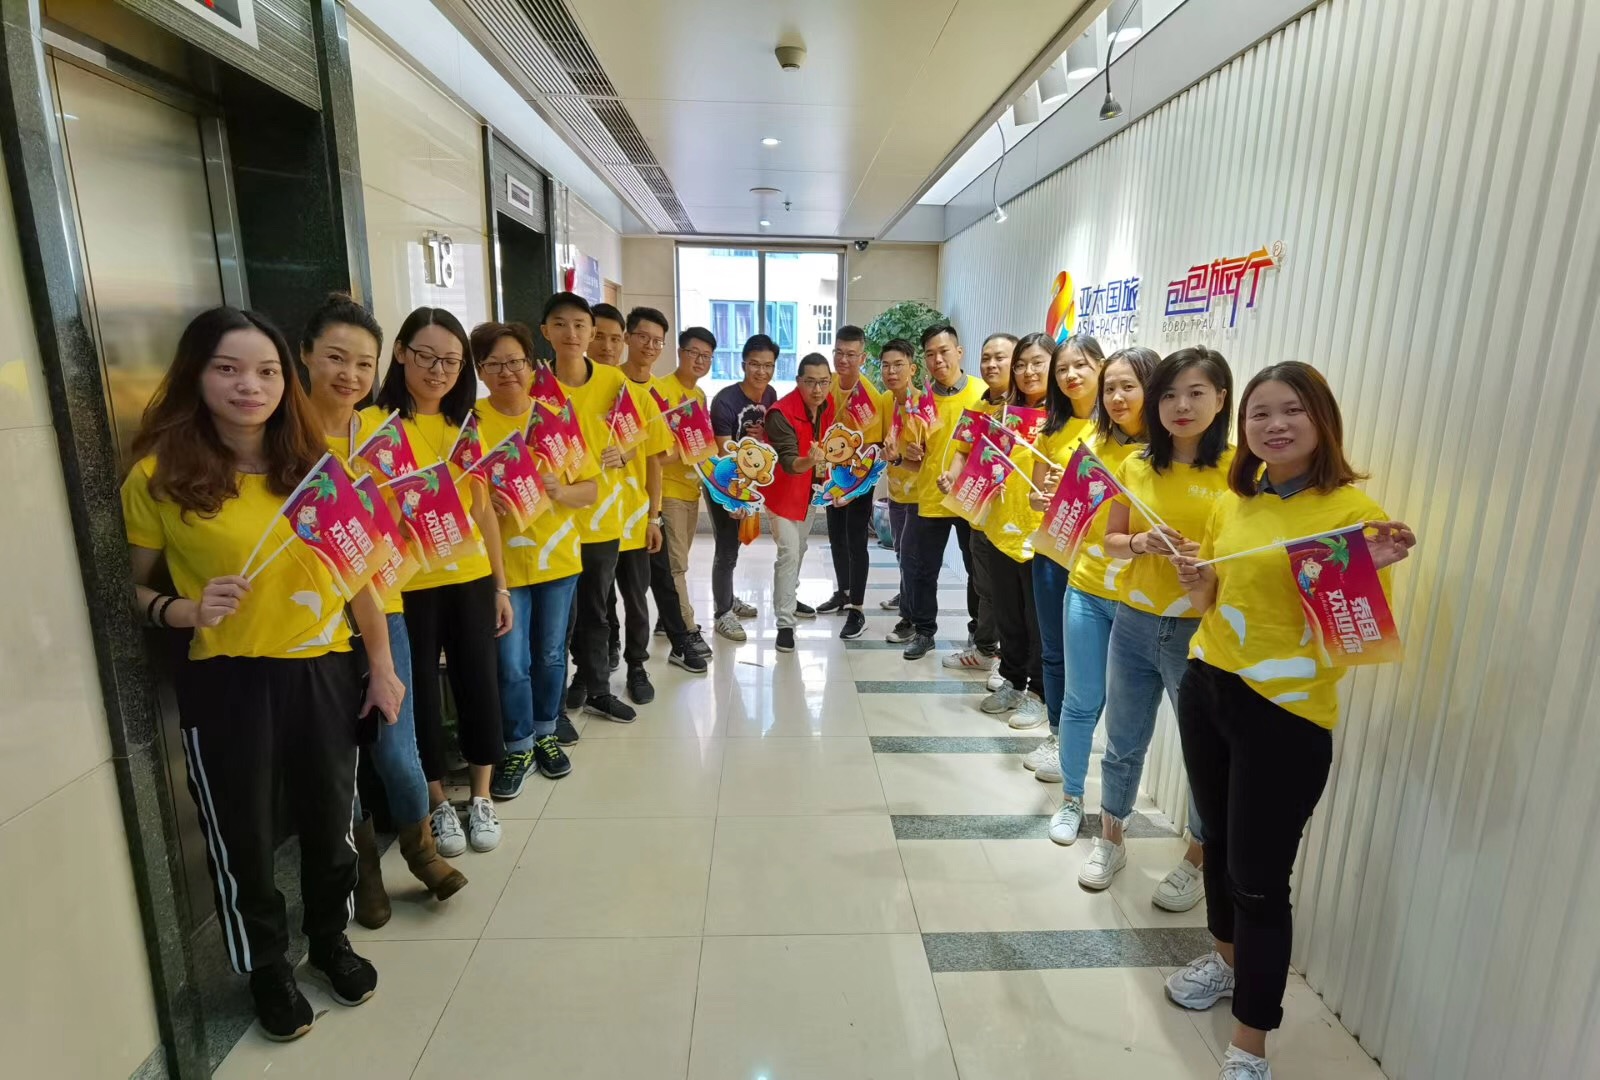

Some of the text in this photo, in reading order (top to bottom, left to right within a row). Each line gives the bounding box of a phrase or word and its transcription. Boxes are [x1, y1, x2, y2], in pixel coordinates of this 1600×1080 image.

[426, 233, 455, 288] 18
[1078, 276, 1140, 317] 亚太国旅
[1077, 314, 1136, 336] ASIA-PACIFIC
[1350, 596, 1382, 642] 泰国
